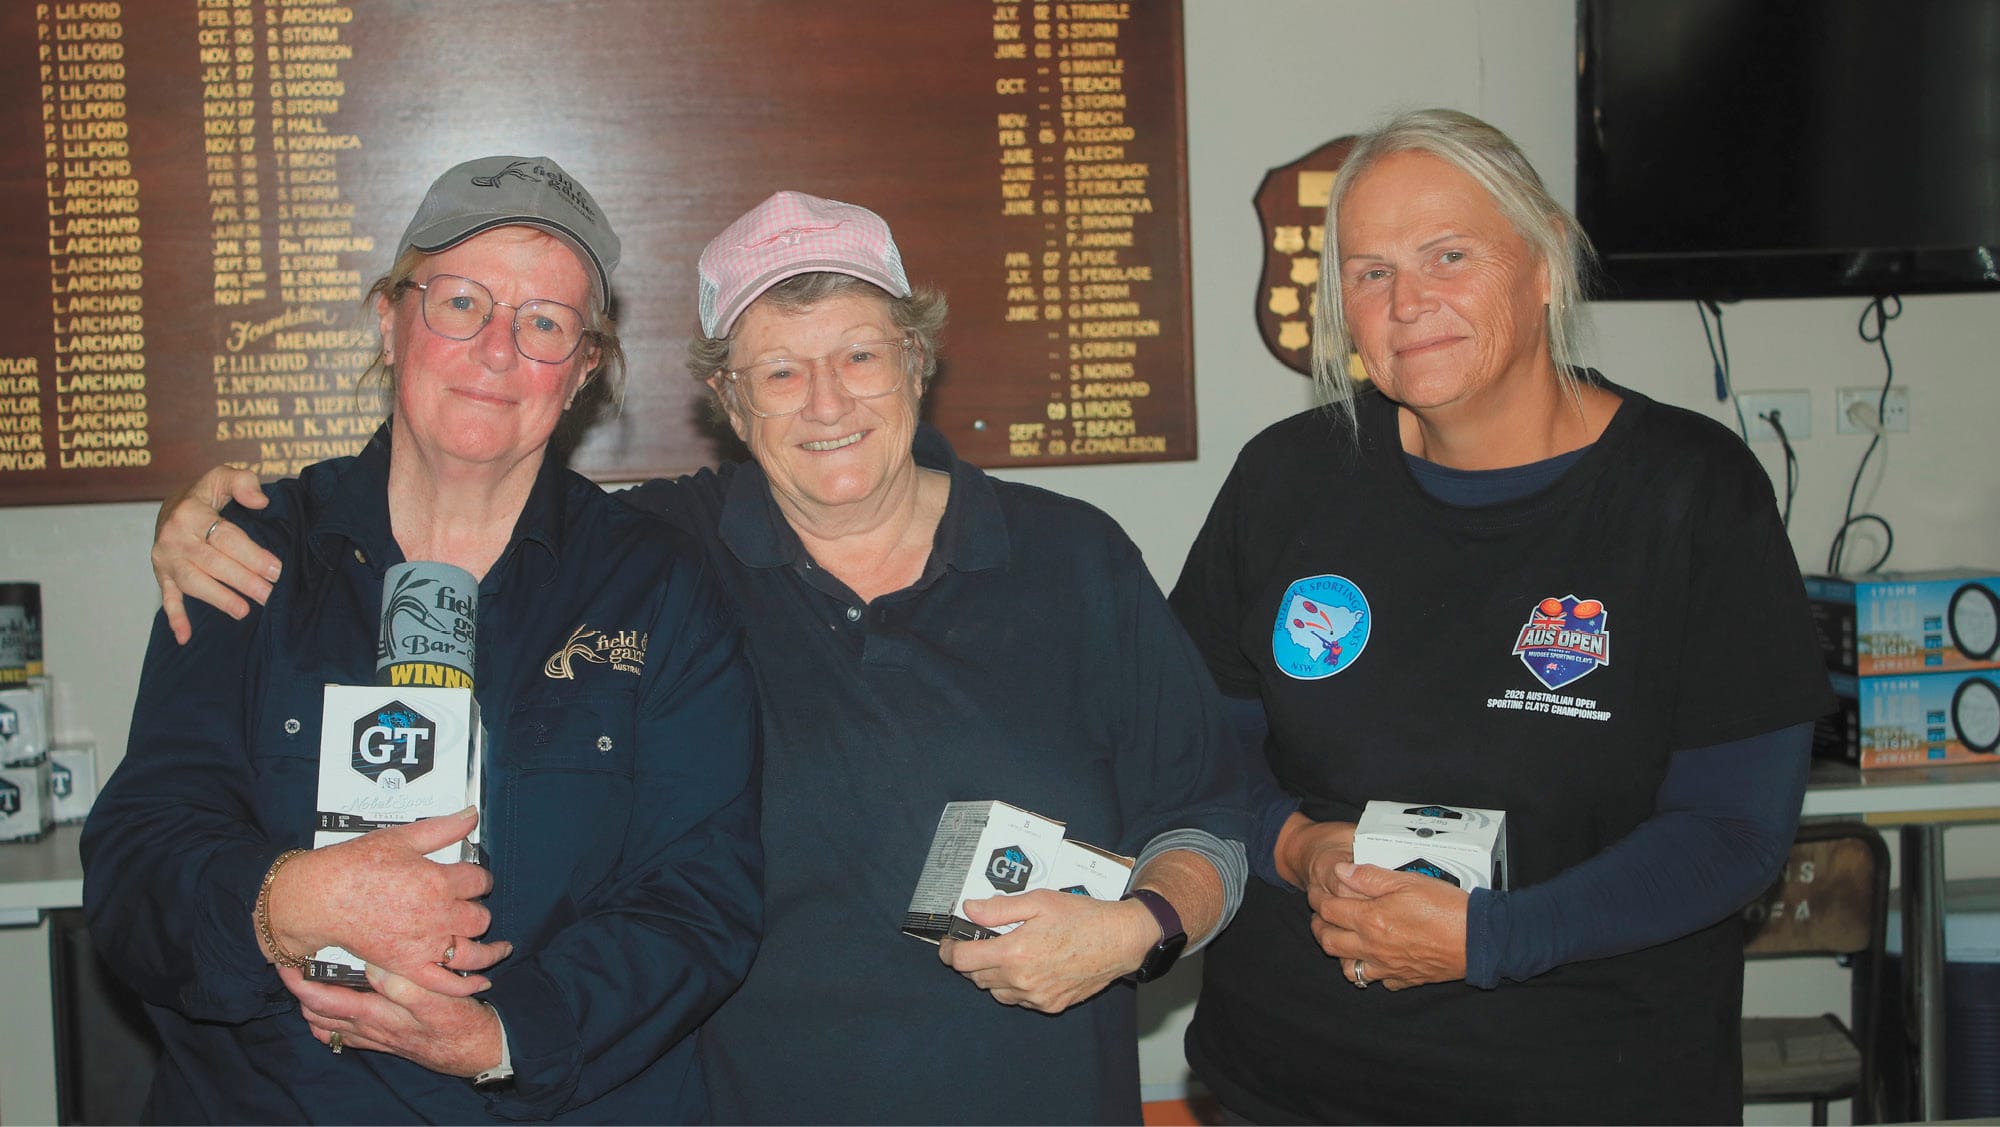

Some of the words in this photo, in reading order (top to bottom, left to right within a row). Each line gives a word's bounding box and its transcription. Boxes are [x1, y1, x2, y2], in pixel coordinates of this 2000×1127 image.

[56, 3, 121, 20] LILFORD
[57, 23, 123, 40] LILFORD
[57, 43, 124, 61] LILFORD
[59, 63, 126, 81] LILFORD
[60, 83, 126, 101] LILFORD
[61, 102, 126, 120] LILFORD
[62, 122, 128, 140] LILFORD
[64, 141, 129, 158] LILFORD
[64, 160, 131, 178] LILFORD
[64, 179, 139, 196] ARCHARD
[65, 198, 139, 214] ARCHARD
[67, 217, 140, 234] ARCHARD
[66, 236, 142, 253] ARCHARD
[67, 256, 143, 272] ARCHARD
[67, 274, 143, 292] ARCHARD
[69, 295, 143, 312] ARCHARD
[69, 315, 144, 332] ARCHARD
[0, 357, 38, 375] YLOR
[0, 376, 40, 394] YLOR
[1309, 581, 1360, 609] SPORTING
[595, 630, 638, 652] field
[1521, 628, 1558, 648] AUS
[1558, 630, 1604, 656] OPEN
[1291, 661, 1313, 673] NSW
[1575, 656, 1592, 664] CLAYS
[1505, 690, 1525, 699] 2026
[1526, 691, 1574, 706] AUSTRALIAN
[1575, 698, 1597, 709] OPEN
[1487, 699, 1523, 709] SPORTING
[1525, 701, 1549, 713] CLAYS
[1551, 705, 1612, 721] CHAMPIONSHIP
[359, 725, 429, 765] GT
[991, 856, 1028, 884] GT
